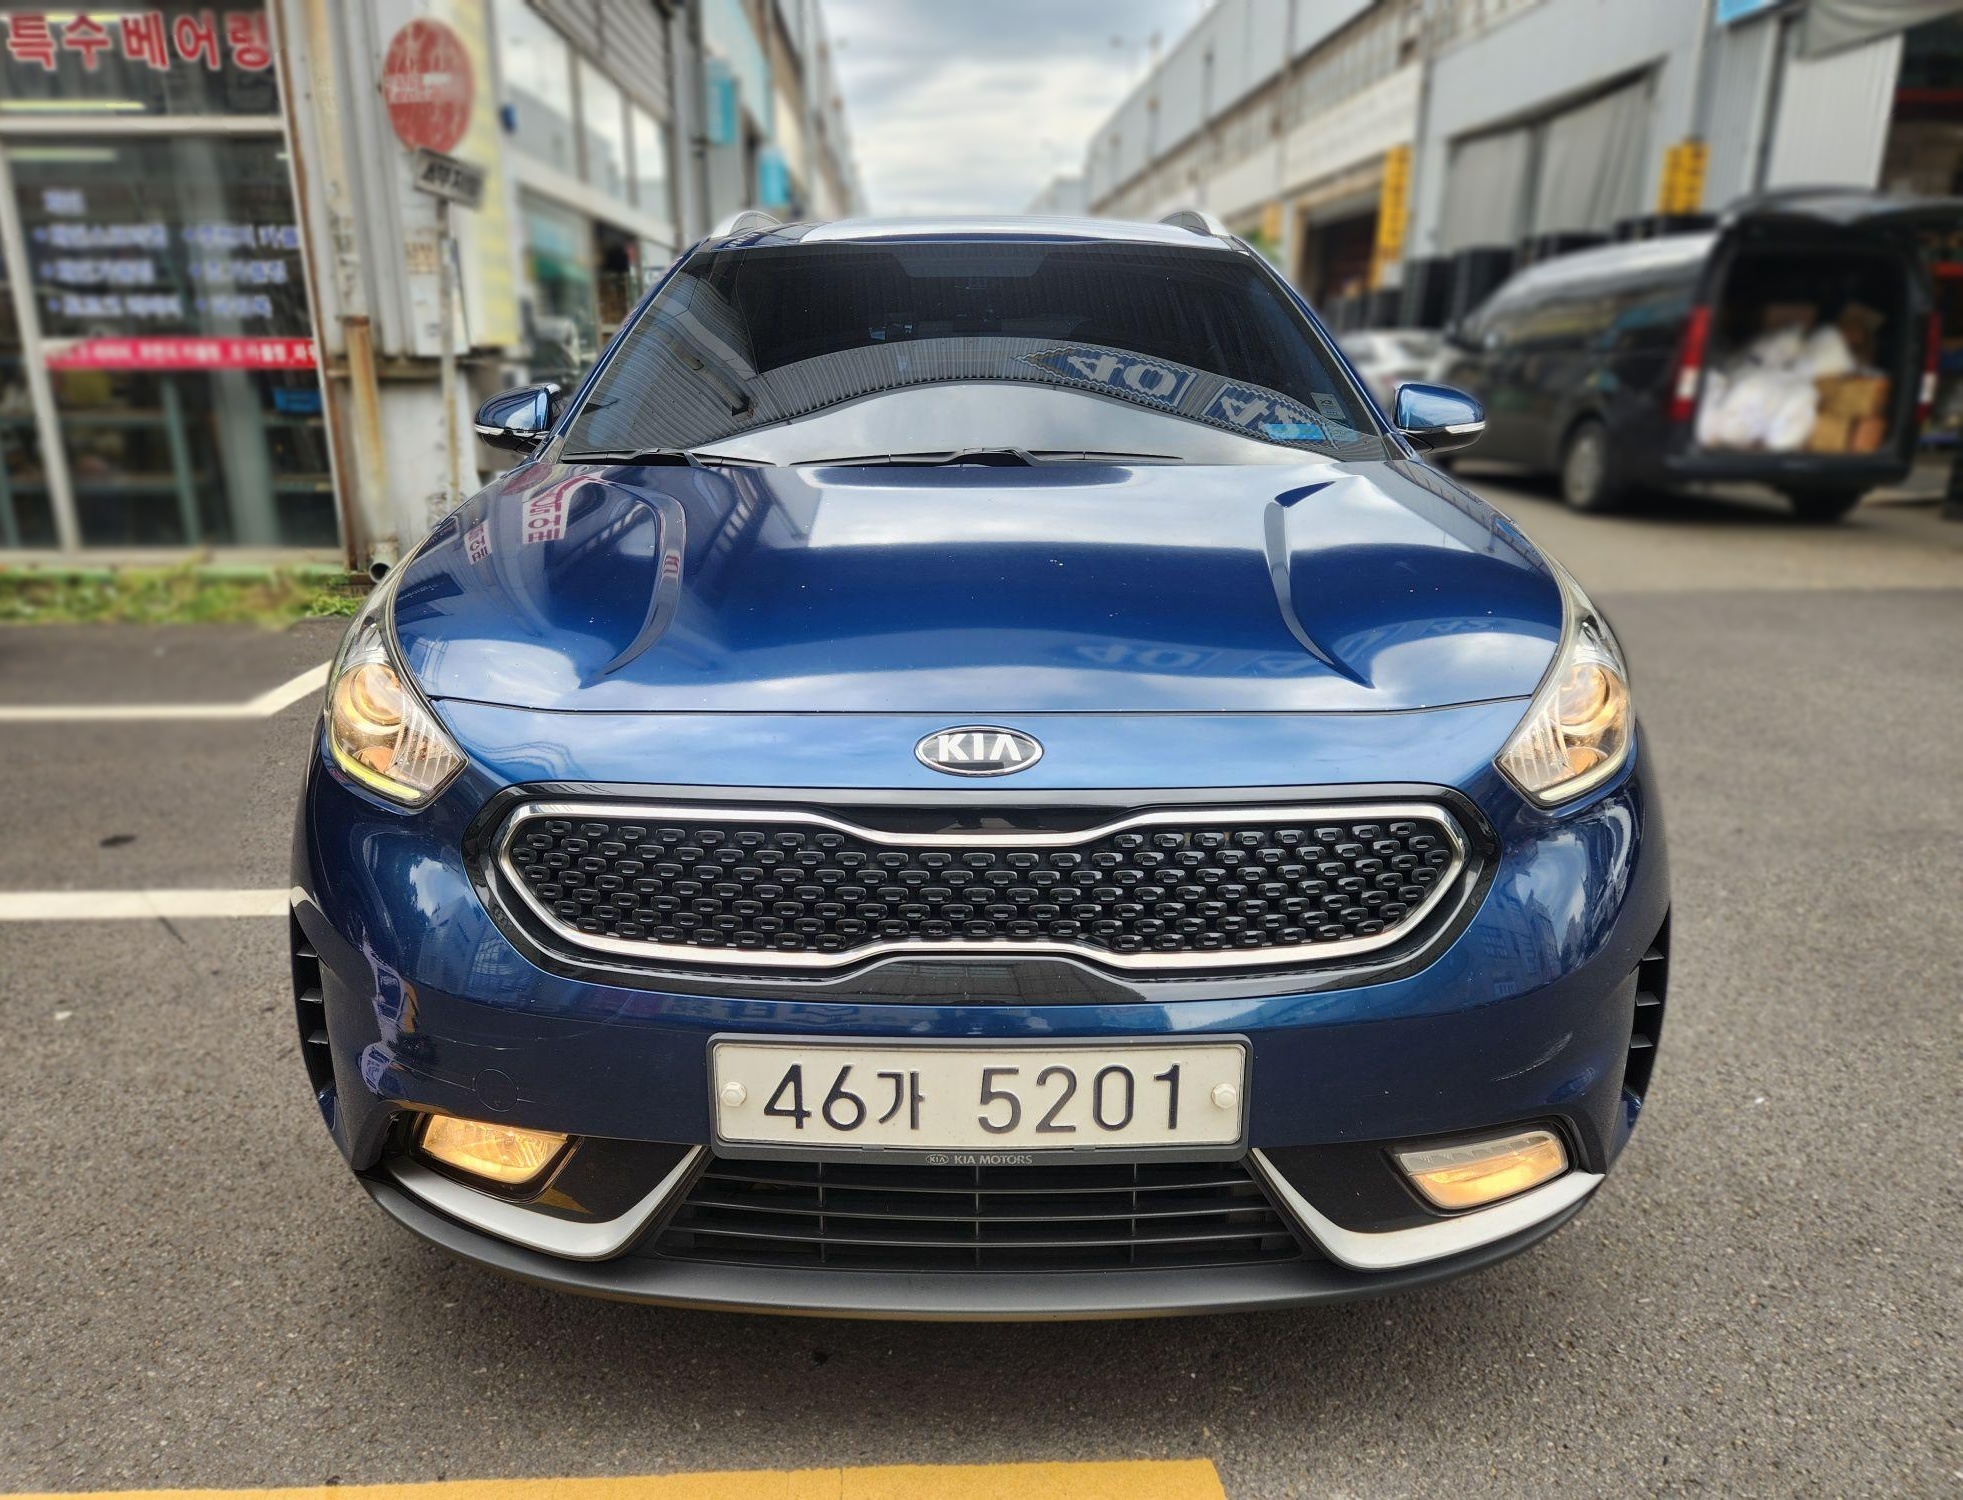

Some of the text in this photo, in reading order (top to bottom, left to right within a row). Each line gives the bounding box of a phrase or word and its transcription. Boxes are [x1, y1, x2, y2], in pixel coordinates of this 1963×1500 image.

[938, 733, 1022, 762] KIA
[764, 1063, 1182, 1134] 46가 5201
[954, 1154, 977, 1165] KIA
[979, 1154, 1034, 1165] MOTORS
